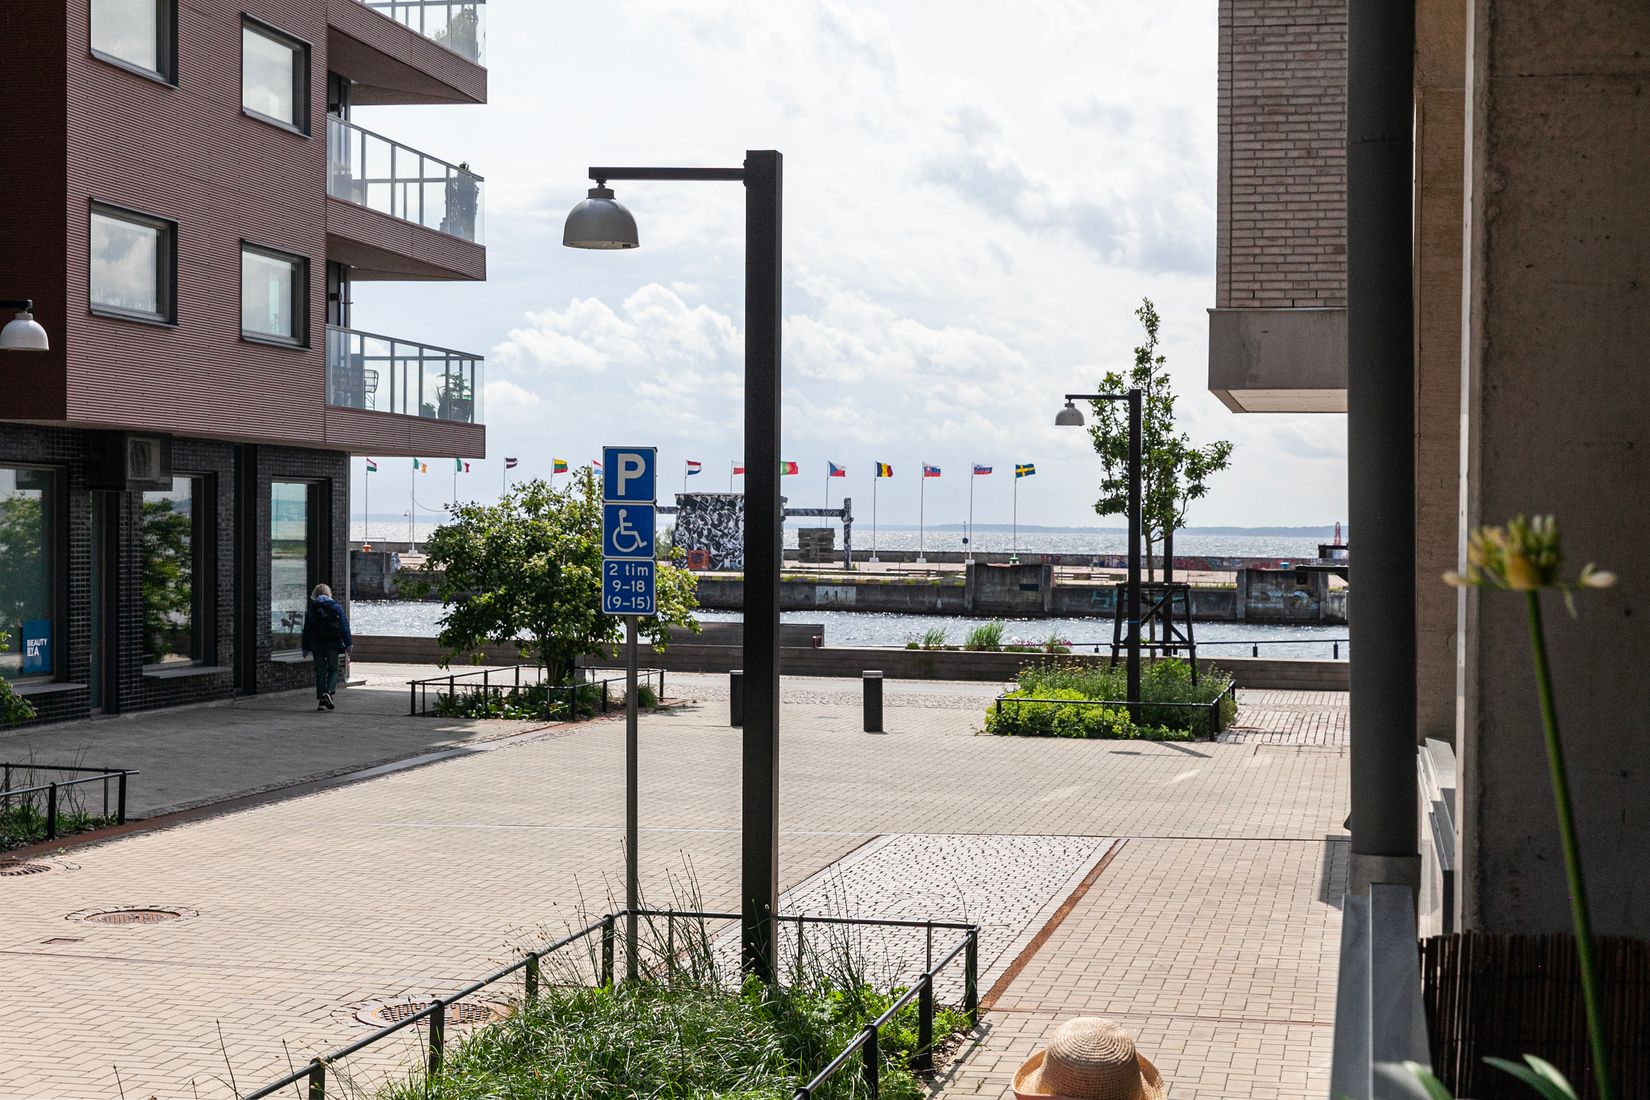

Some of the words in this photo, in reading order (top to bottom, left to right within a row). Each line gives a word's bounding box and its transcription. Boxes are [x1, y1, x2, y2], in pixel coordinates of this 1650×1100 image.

[617, 453, 646, 496] P
[609, 563, 618, 576] 2
[625, 563, 649, 576] tim
[612, 580, 646, 592] 9-18
[607, 595, 651, 610] (9-15)
[27, 638, 47, 646] BEAUTY
